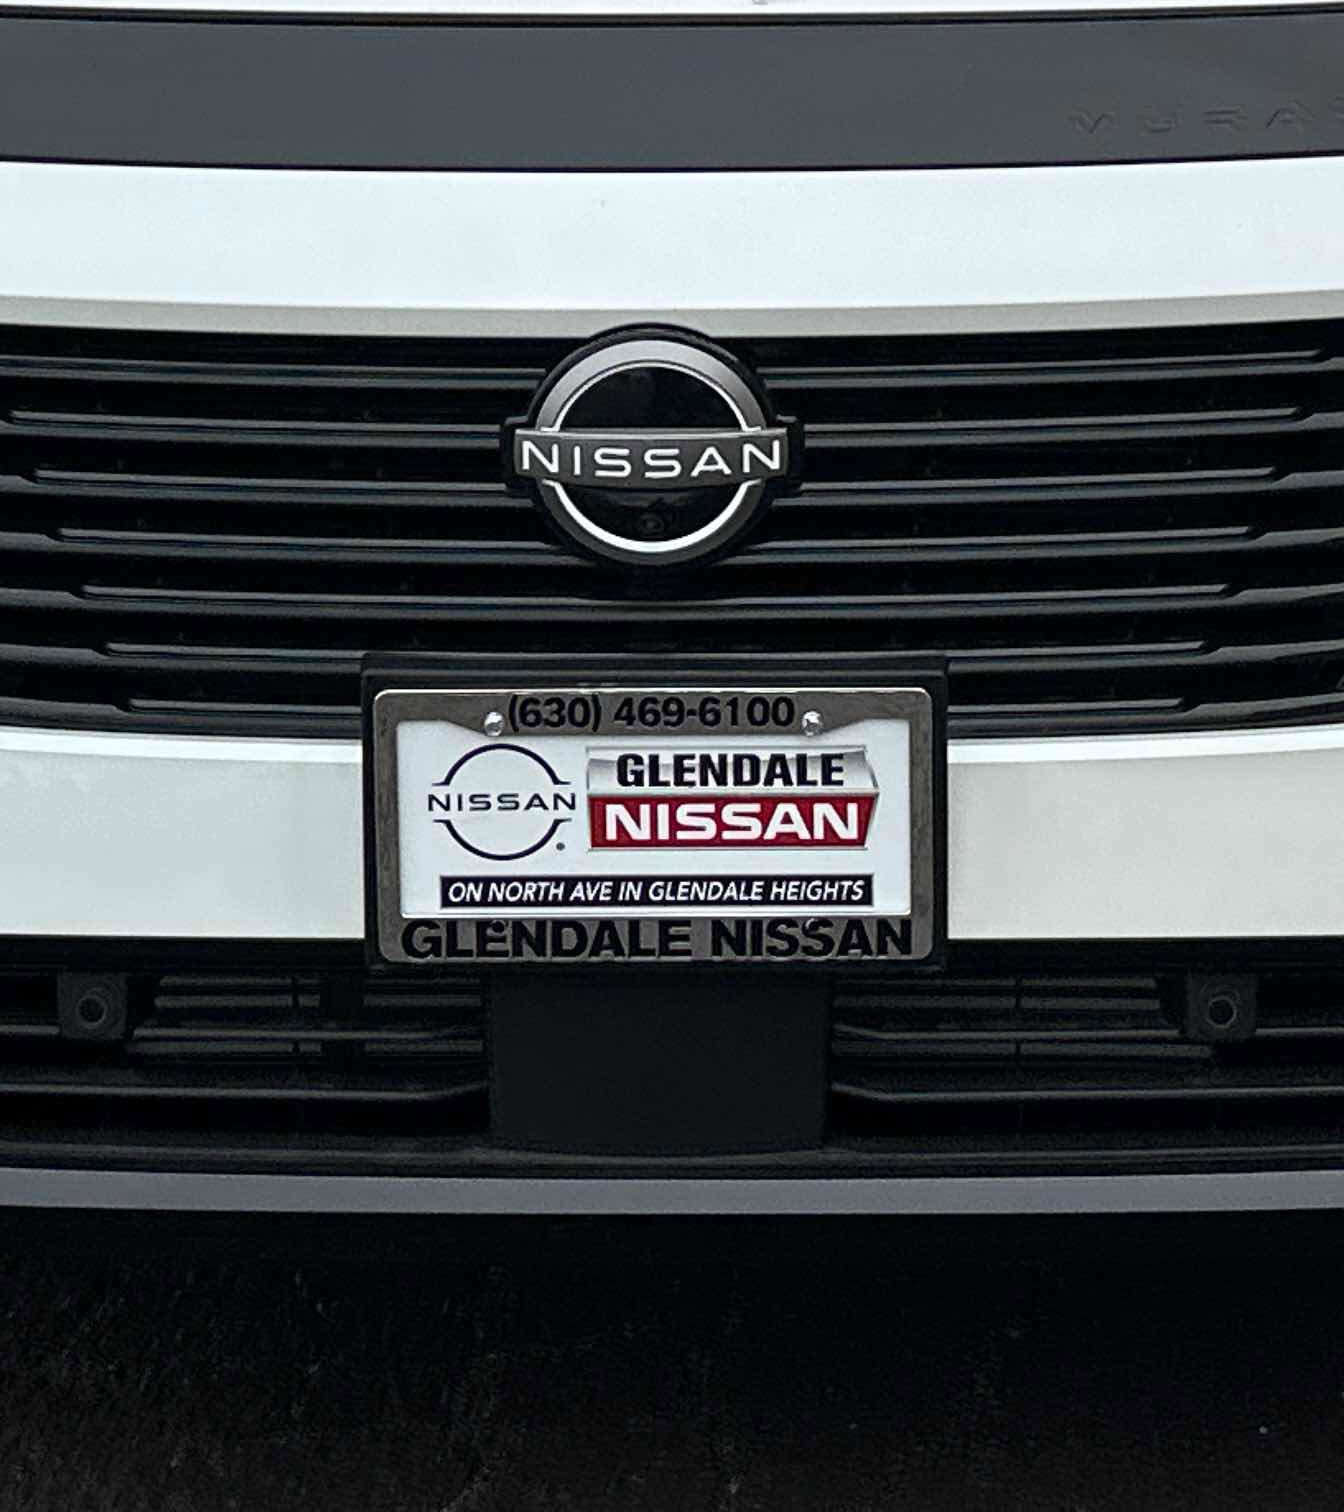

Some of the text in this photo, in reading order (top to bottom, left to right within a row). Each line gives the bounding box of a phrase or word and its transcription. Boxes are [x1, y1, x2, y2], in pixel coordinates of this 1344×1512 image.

[522, 439, 780, 478] NISSAN
[508, 693, 795, 732] (630) 469-6100
[616, 752, 844, 788] GLENDALE
[427, 792, 576, 812] NISSAN
[605, 802, 857, 841] NISSAN
[448, 879, 864, 903] ON NORTH AVE IN GLENDALE HEIGHTS
[401, 917, 913, 959] GLENDALE NISSAN
